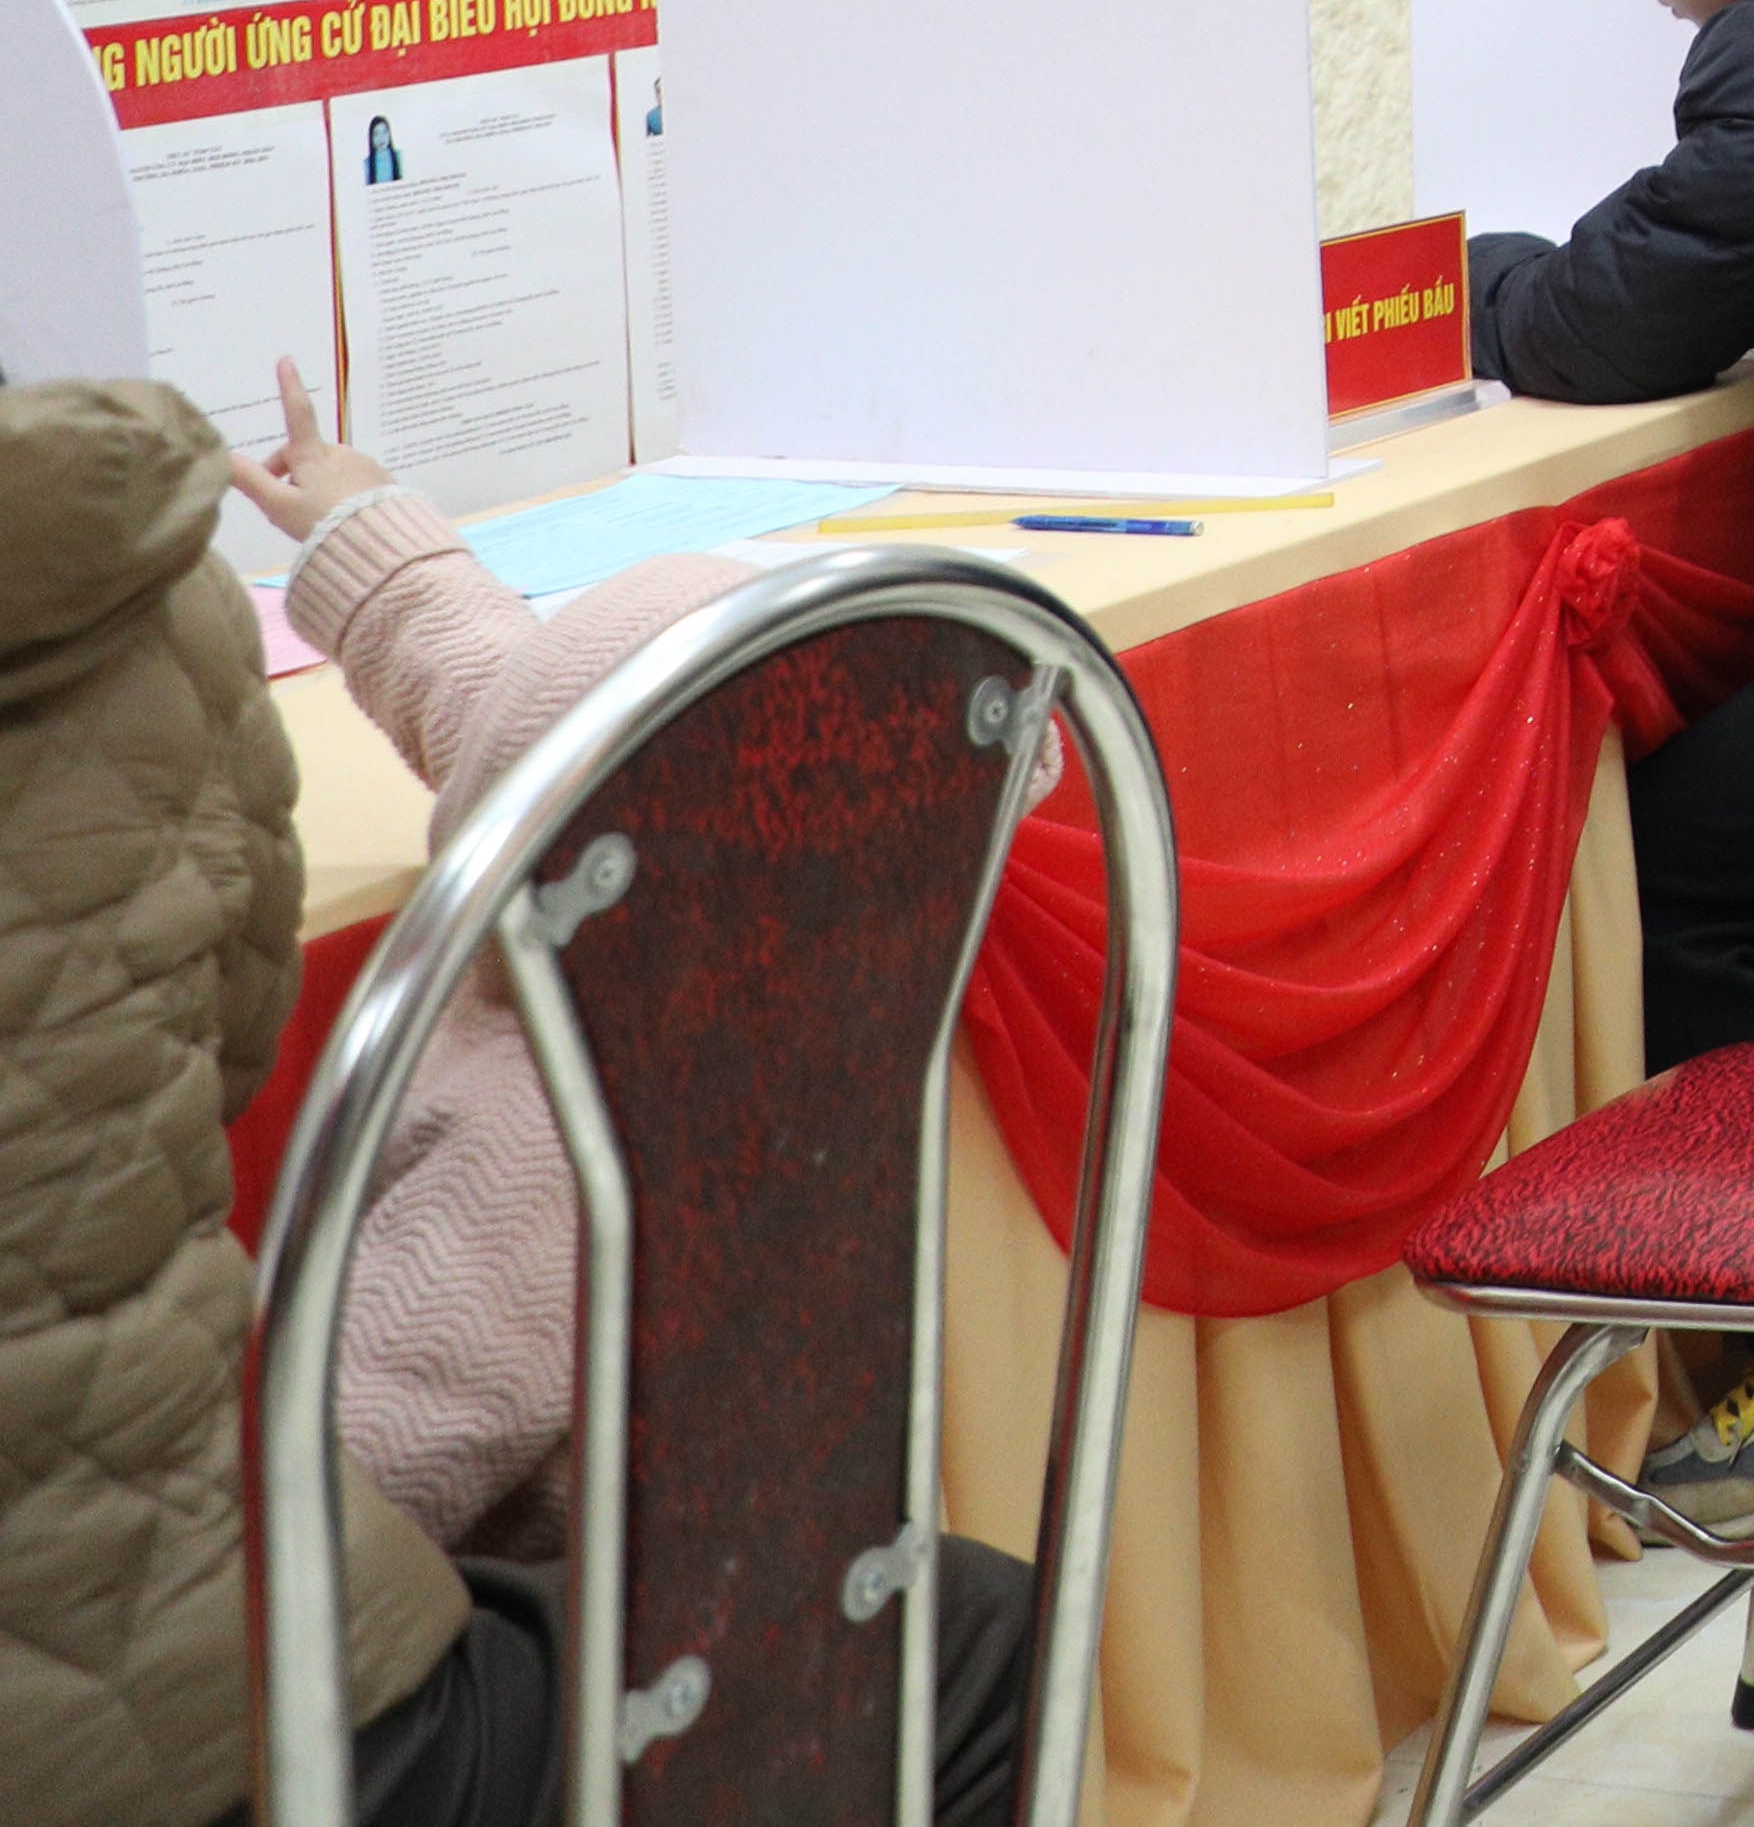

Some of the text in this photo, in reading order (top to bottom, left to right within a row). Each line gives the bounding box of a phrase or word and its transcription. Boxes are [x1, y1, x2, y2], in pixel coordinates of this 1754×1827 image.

[135, 16, 237, 87] NGƯỜI
[246, 12, 313, 70] ỨNG
[370, 0, 422, 58] ĐẠI
[1335, 294, 1370, 341] VIẾT
[1373, 283, 1420, 332] PHIẾU
[1423, 275, 1455, 320] BẦU
